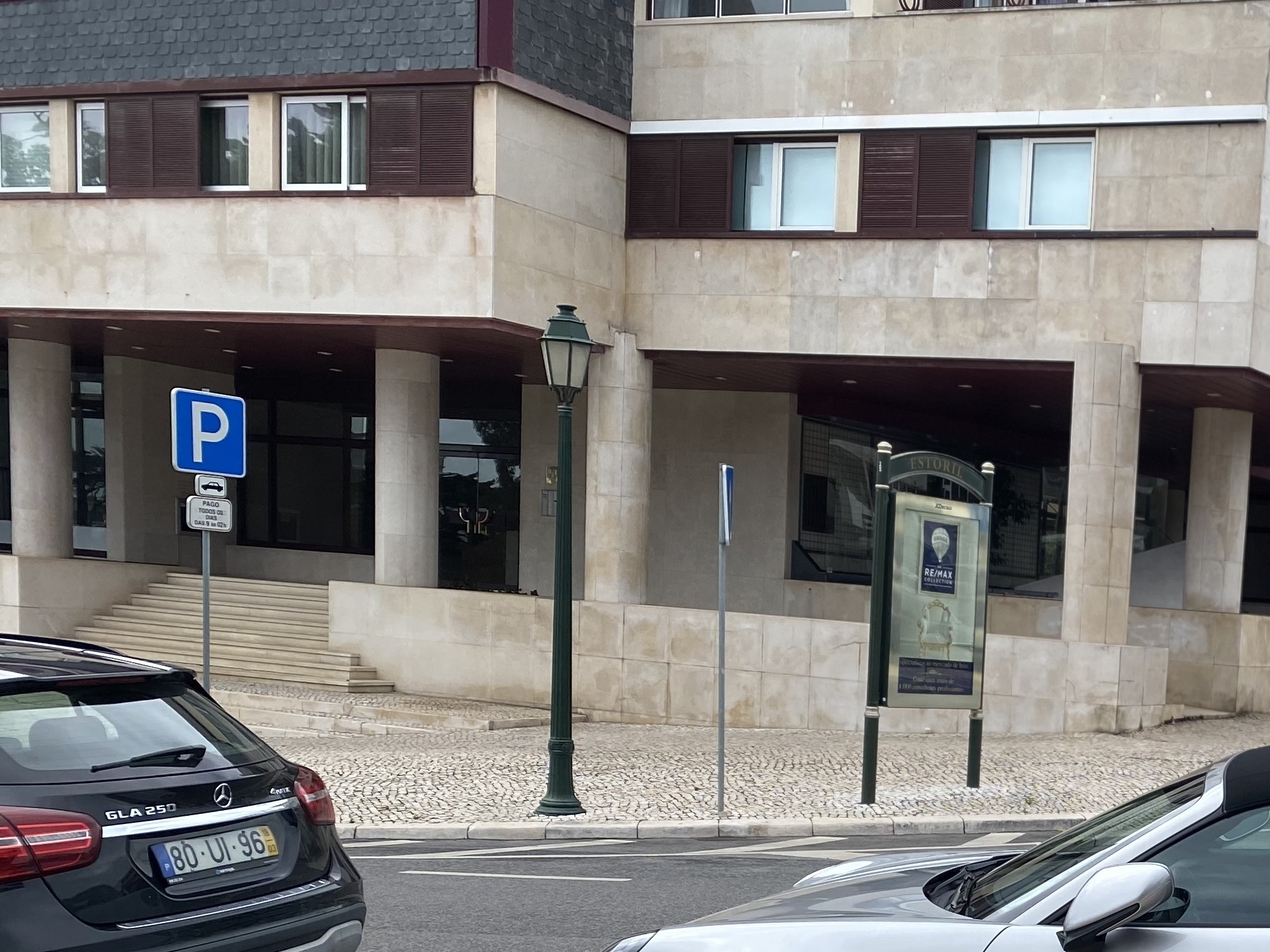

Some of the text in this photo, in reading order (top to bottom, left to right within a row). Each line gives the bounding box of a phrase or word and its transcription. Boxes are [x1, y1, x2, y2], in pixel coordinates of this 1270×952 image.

[191, 401, 230, 463] P
[910, 456, 963, 478] ESTORIL
[202, 500, 220, 508] PAGO
[198, 507, 216, 515] TODOS
[924, 568, 953, 579] RE/MAX
[924, 577, 953, 585] COLLECTION
[104, 803, 177, 820] GLA 250
[164, 863, 170, 871] P
